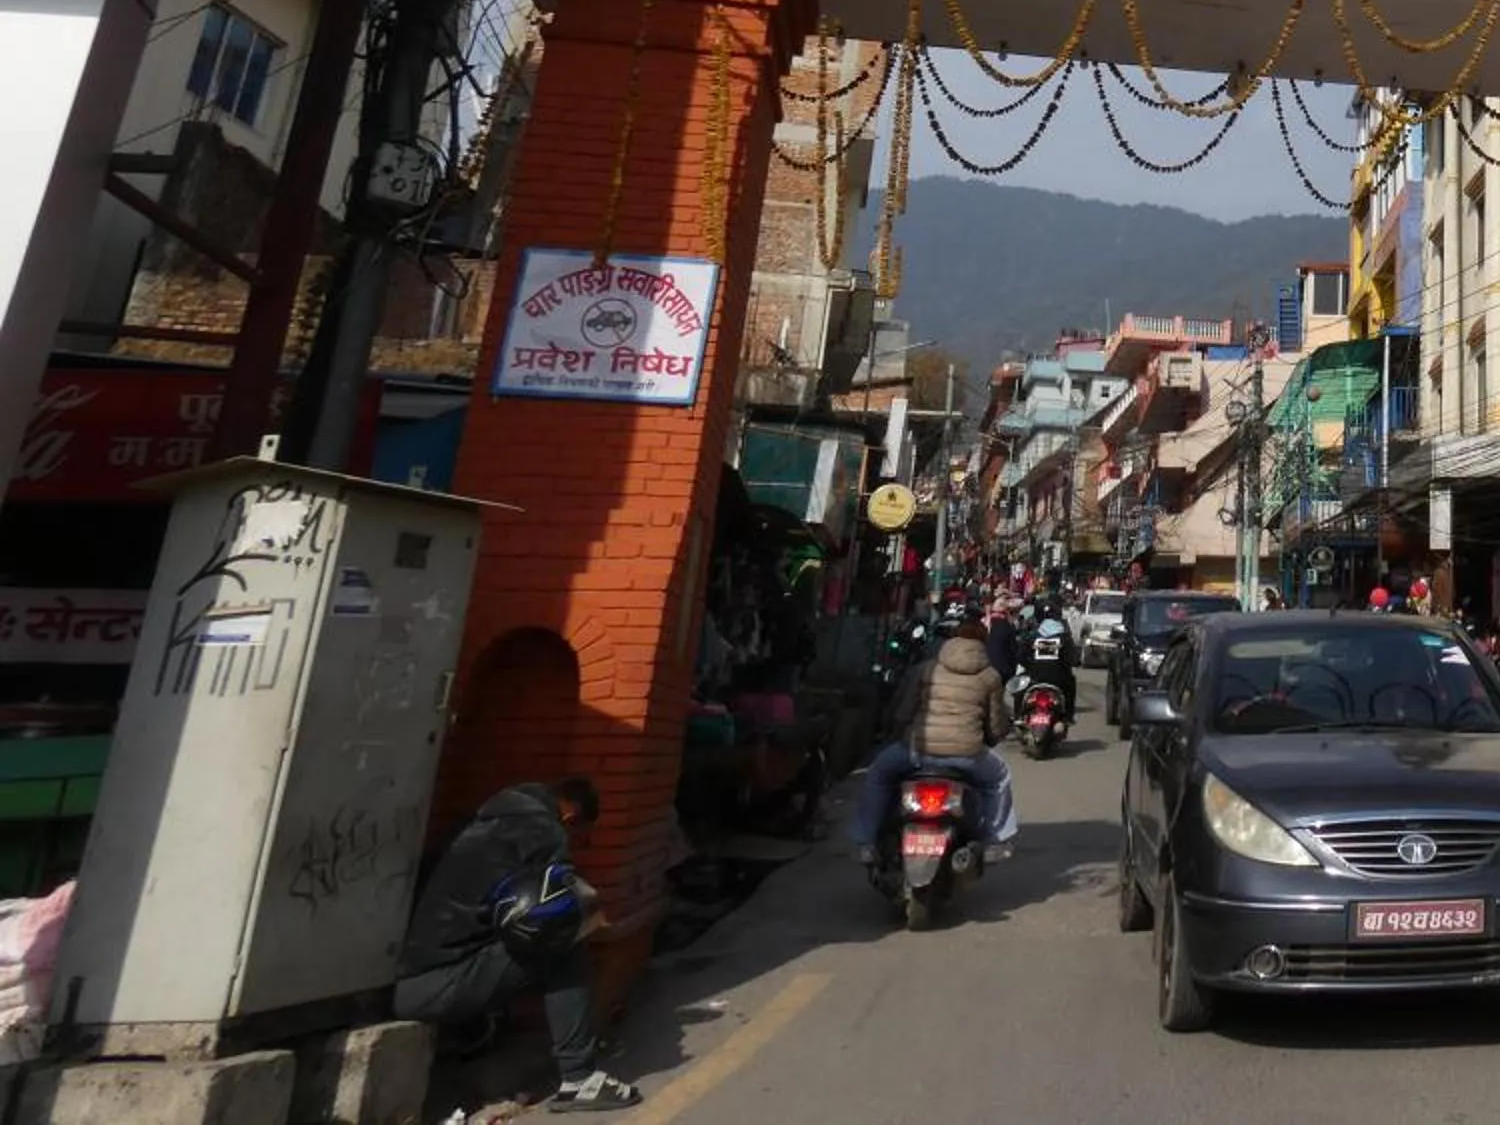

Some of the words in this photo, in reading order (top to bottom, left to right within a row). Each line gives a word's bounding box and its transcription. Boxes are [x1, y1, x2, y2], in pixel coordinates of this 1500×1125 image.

[522, 286, 562, 320] चार
[511, 341, 596, 373] प्रवेश
[611, 346, 694, 377] निषेध
